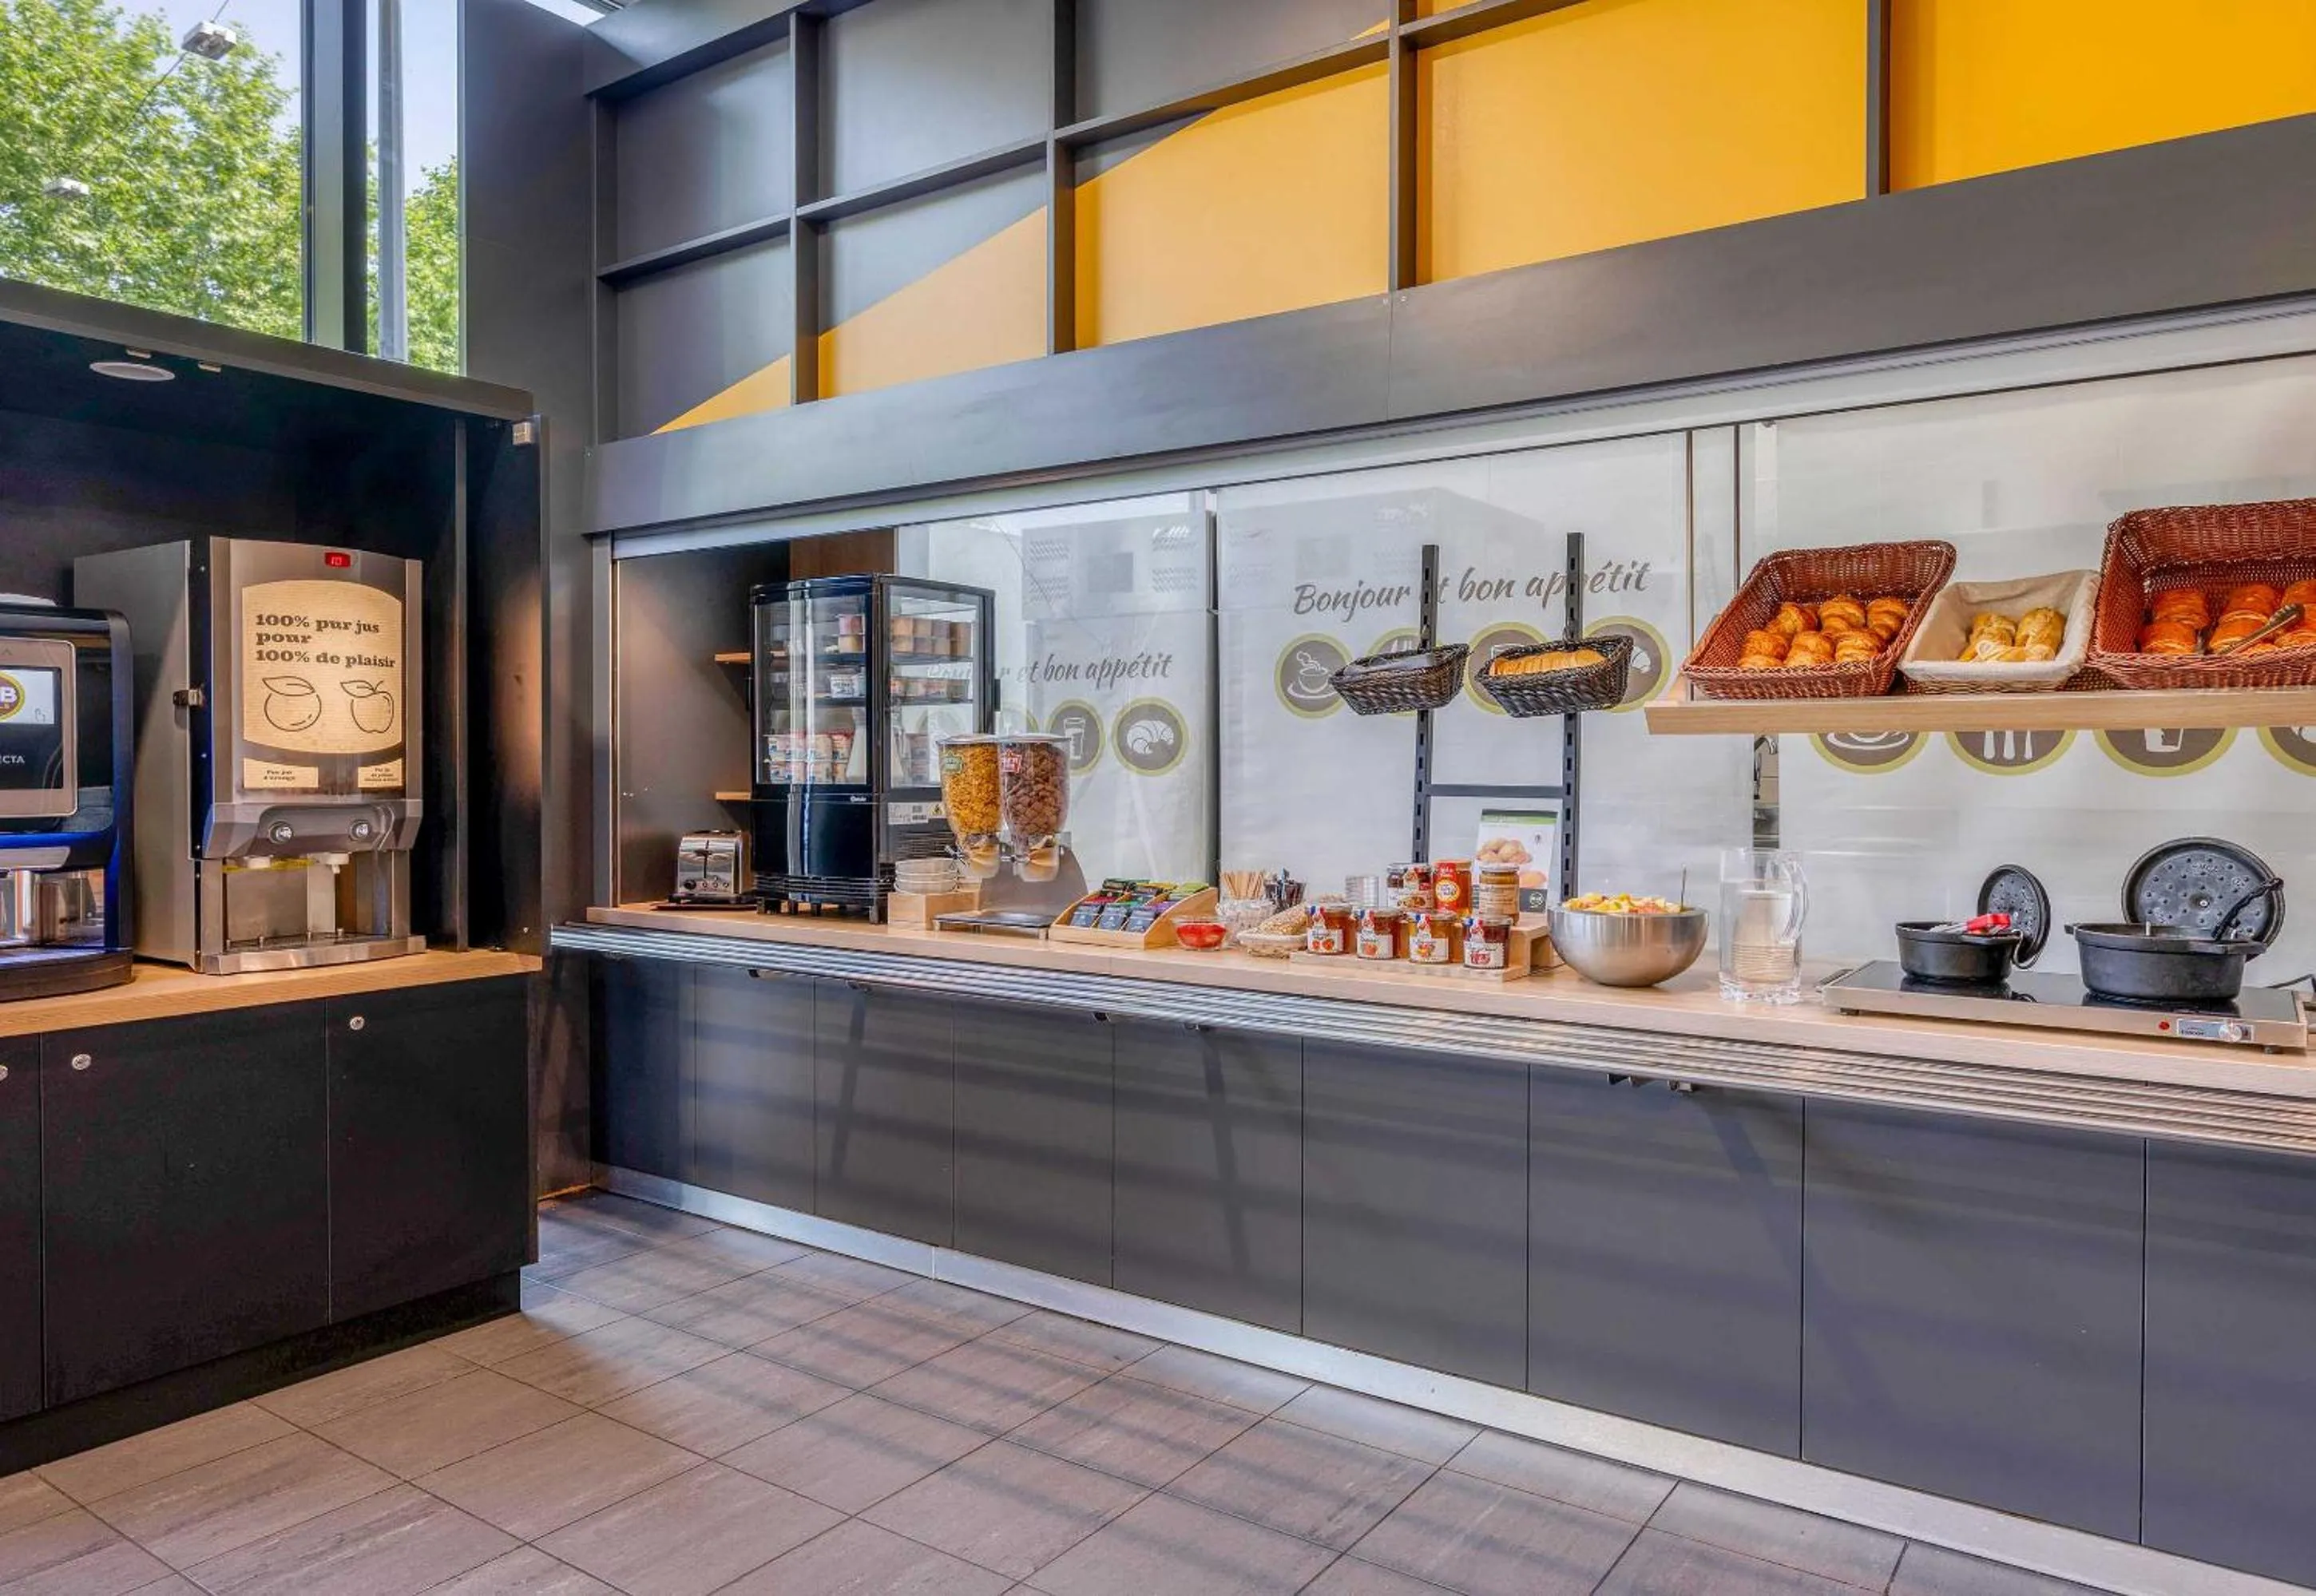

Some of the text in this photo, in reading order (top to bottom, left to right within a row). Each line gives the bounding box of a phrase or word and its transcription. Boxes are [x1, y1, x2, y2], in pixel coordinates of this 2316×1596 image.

[1293, 580, 1411, 623] Bonjour
[1457, 566, 1516, 602] bon
[1525, 559, 1652, 609] apétit
[256, 614, 379, 635] 100% pur jus
[256, 632, 312, 645] pour
[256, 649, 396, 668] 100% de plaisir
[1016, 660, 1039, 683] et
[1040, 653, 1080, 683] bon
[1085, 651, 1173, 690] appétit
[0, 754, 25, 764] CTA
